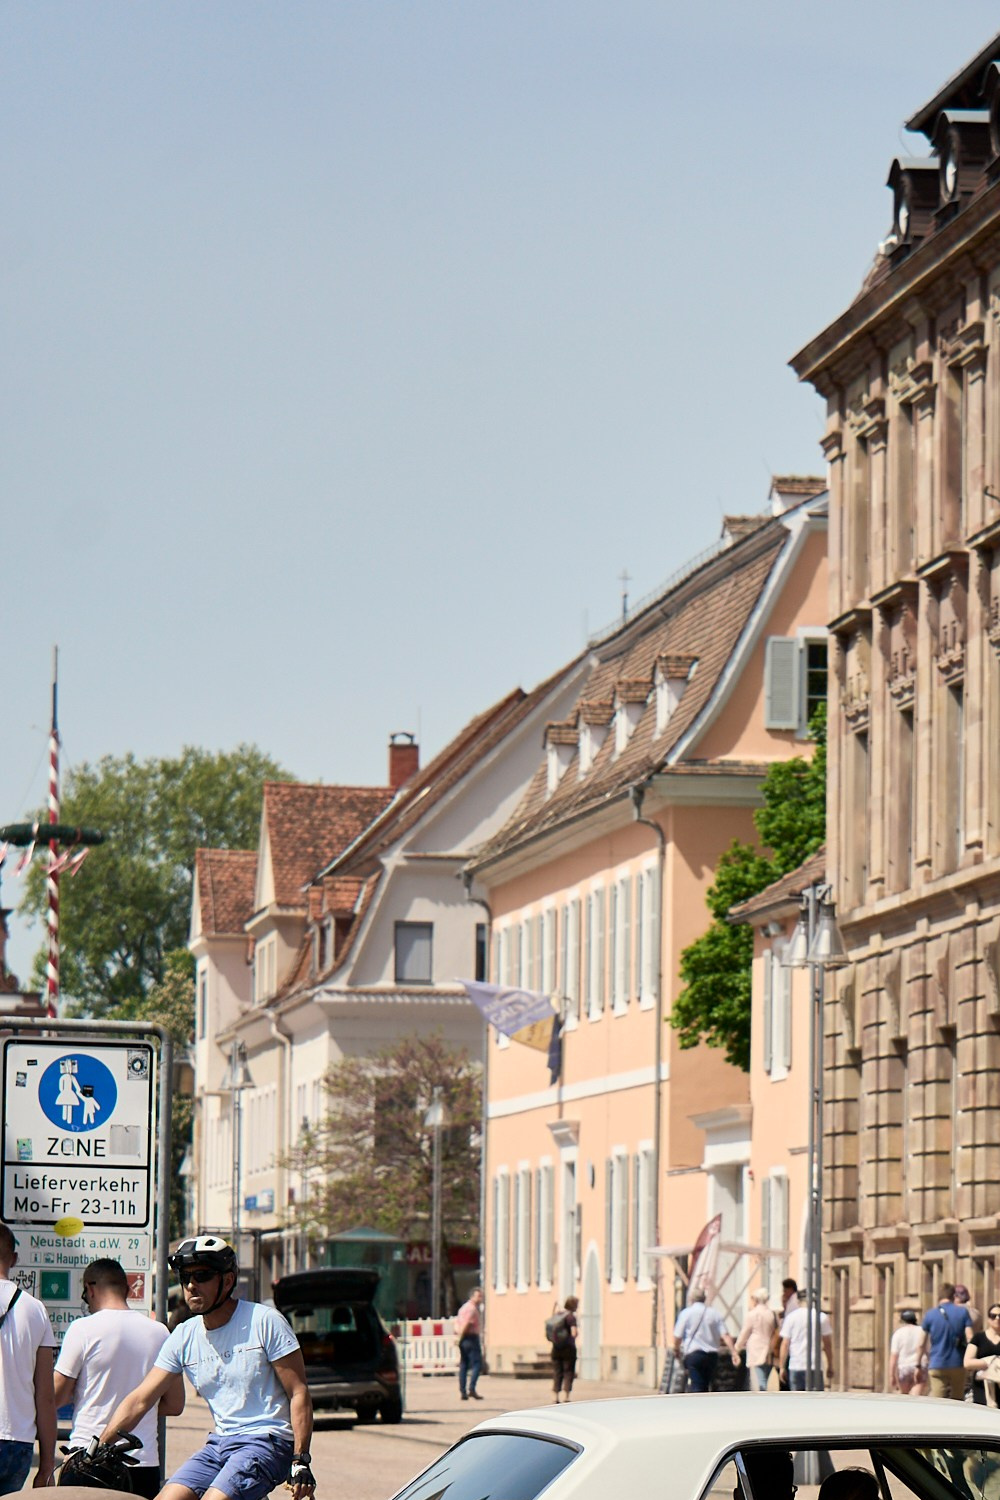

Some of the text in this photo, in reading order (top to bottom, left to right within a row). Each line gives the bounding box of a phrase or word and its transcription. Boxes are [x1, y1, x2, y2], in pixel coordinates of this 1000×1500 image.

[47, 1137, 106, 1157] ZONE
[13, 1173, 140, 1192] Lieferverkehr
[14, 1196, 71, 1213] Mo-Fr
[30, 1235, 140, 1250] Neustadt a.d.W. 29
